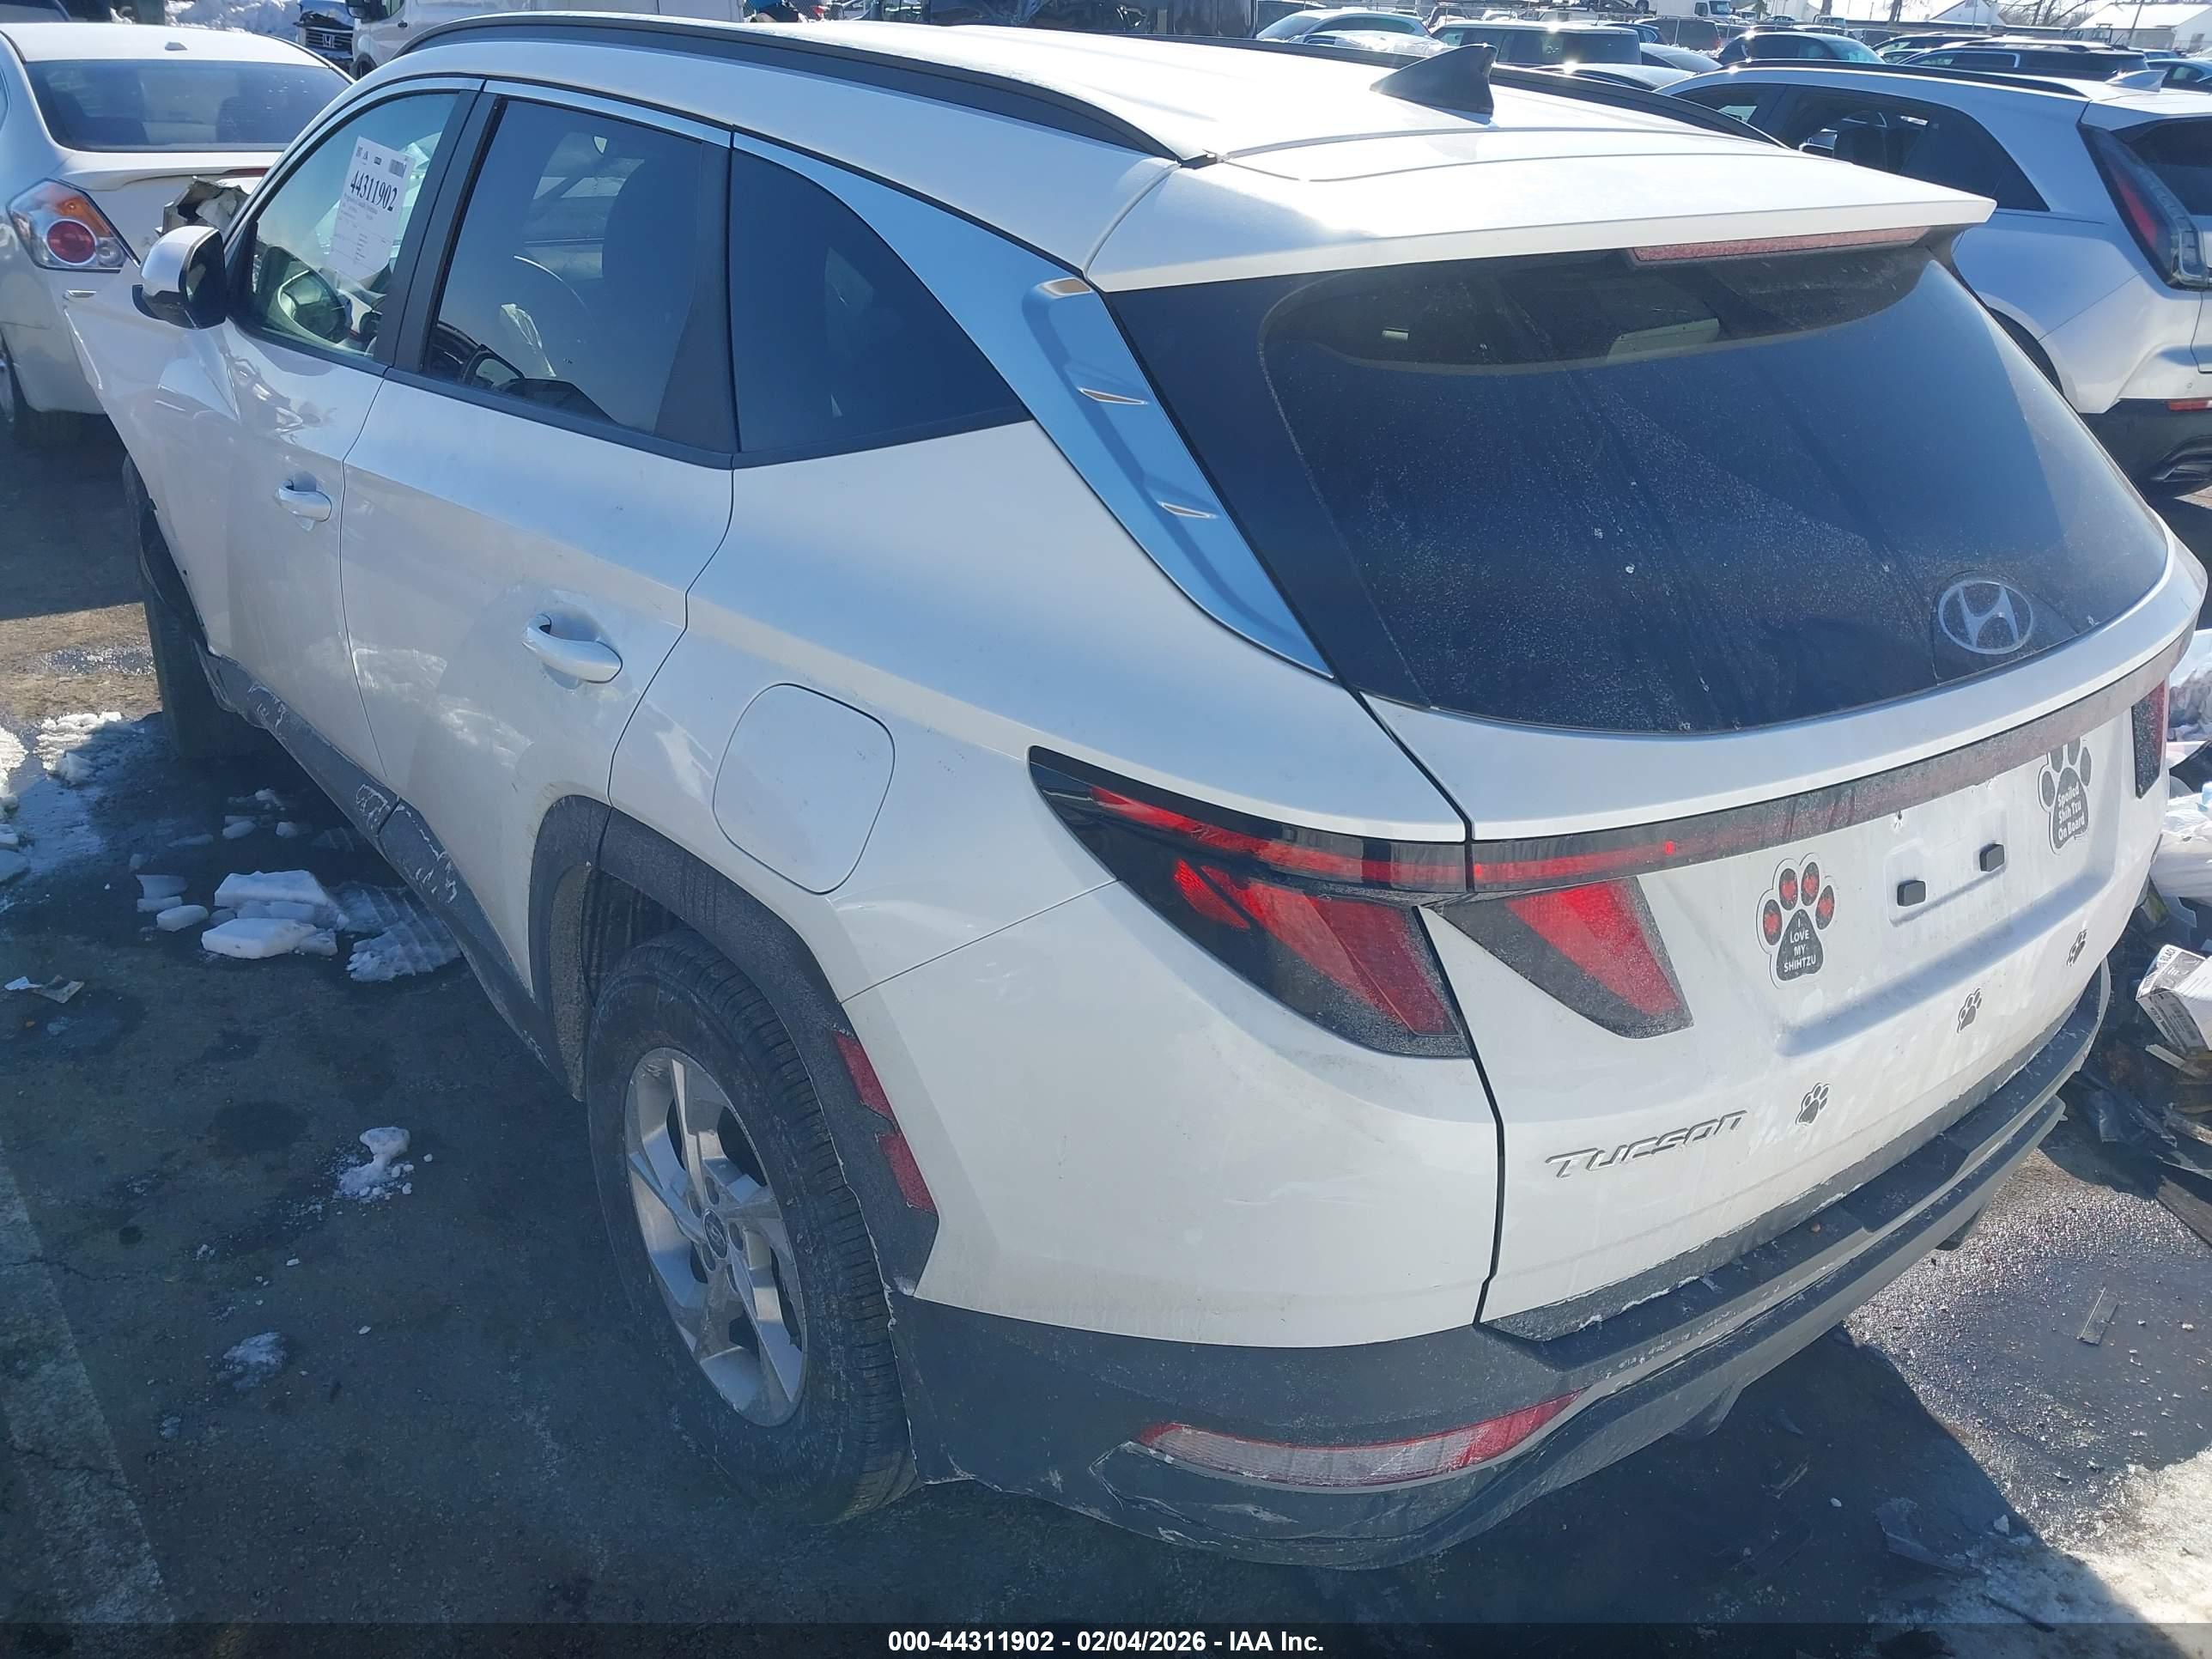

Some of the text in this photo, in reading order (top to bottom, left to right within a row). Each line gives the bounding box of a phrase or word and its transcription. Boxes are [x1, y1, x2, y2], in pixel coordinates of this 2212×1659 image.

[350, 170, 398, 211] 44311902
[2057, 781, 2080, 808] Spoiled
[2058, 800, 2081, 824] Shih Tzu
[2058, 811, 2085, 841] On Board
[1790, 929, 1809, 944] LOVE
[1784, 954, 1816, 973] SHIHTZU
[1794, 945, 1806, 957] MY
[1545, 1109, 1747, 1178] TUCSON
